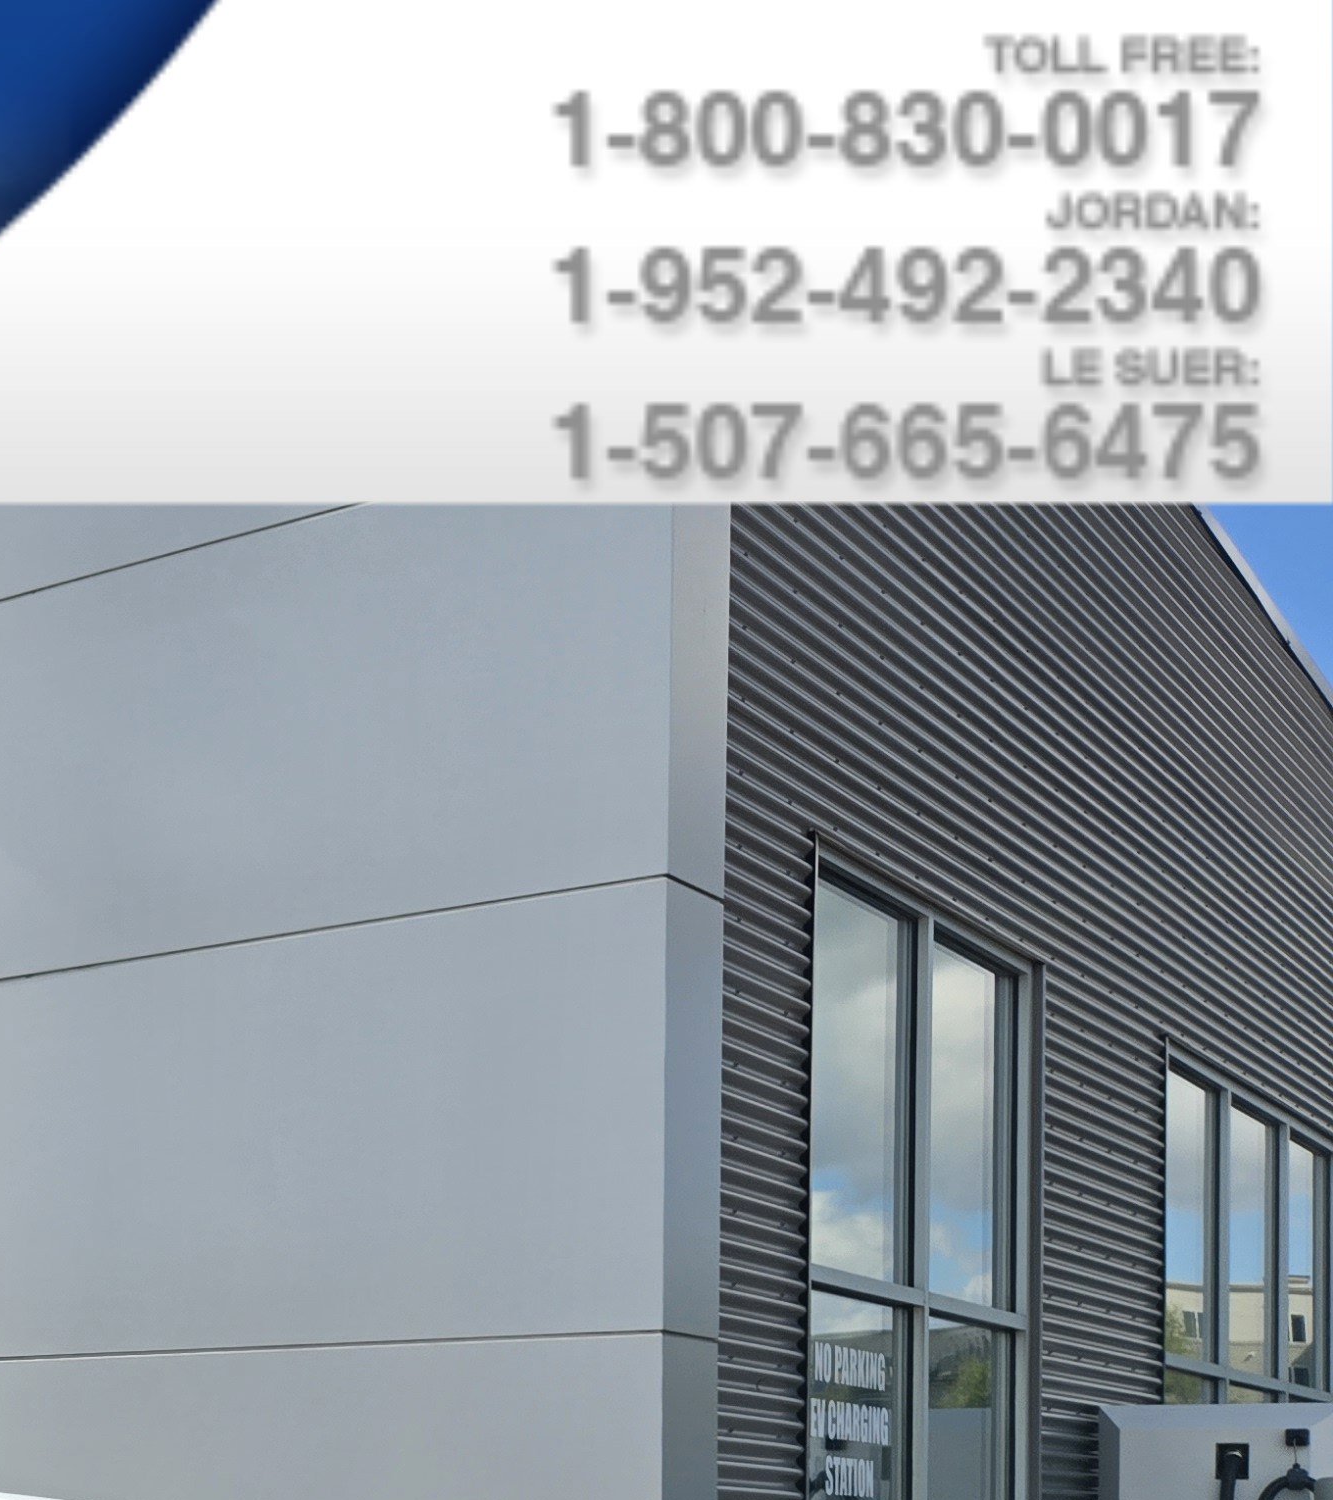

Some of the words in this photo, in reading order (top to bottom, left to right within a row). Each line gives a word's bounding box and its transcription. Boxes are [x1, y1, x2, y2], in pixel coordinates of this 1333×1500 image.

[814, 1341, 832, 1383] NO
[834, 1345, 886, 1392] PARKING
[810, 1397, 826, 1438] EV
[827, 1400, 889, 1446] CHARGING
[825, 1455, 874, 1498] STATION
